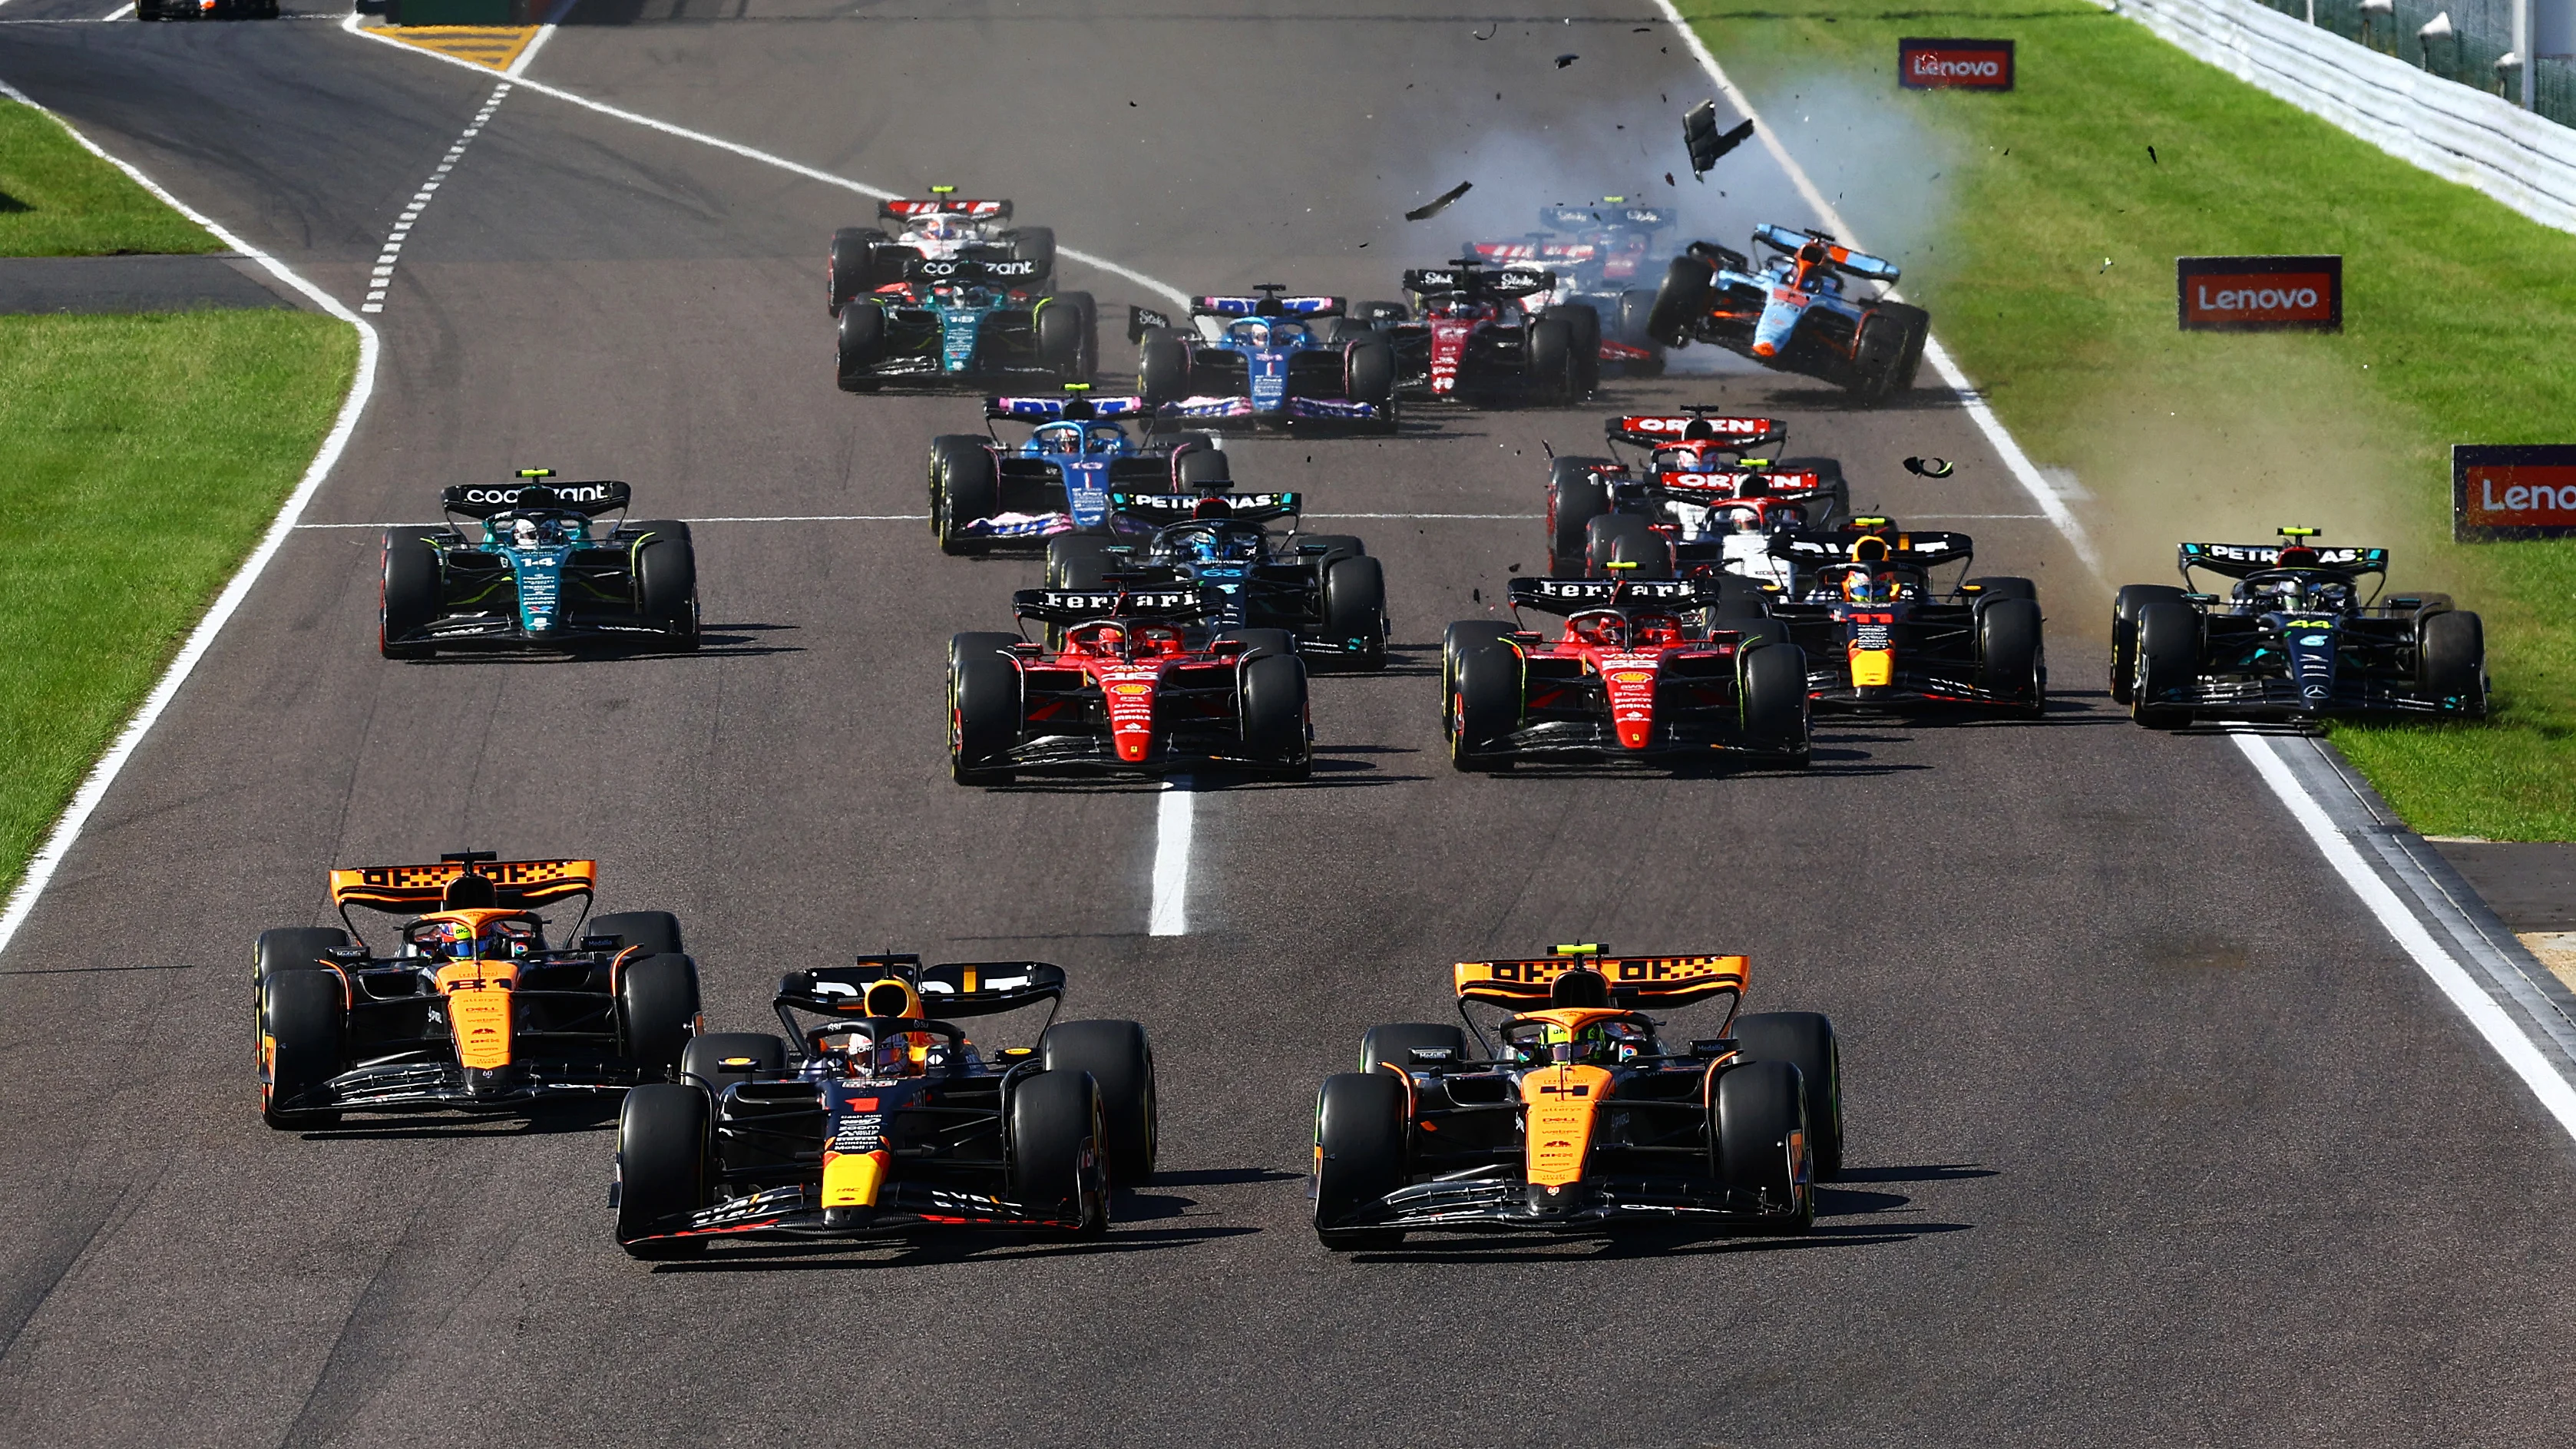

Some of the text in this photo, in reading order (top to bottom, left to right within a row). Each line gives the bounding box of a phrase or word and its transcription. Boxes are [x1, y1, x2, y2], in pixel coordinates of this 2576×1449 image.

[1914, 59, 1999, 76] Lenovo
[2198, 285, 2317, 310] Lenovo
[1639, 418, 1754, 432] OREN
[1677, 474, 1802, 488] ORN
[1136, 495, 1271, 509] PETRNAS
[2211, 544, 2356, 563] PETRAS
[521, 557, 557, 567] 14
[1848, 613, 1893, 624] 11
[2286, 620, 2333, 629] 44
[1619, 958, 1713, 981] OKX
[845, 1097, 880, 1112] 1
